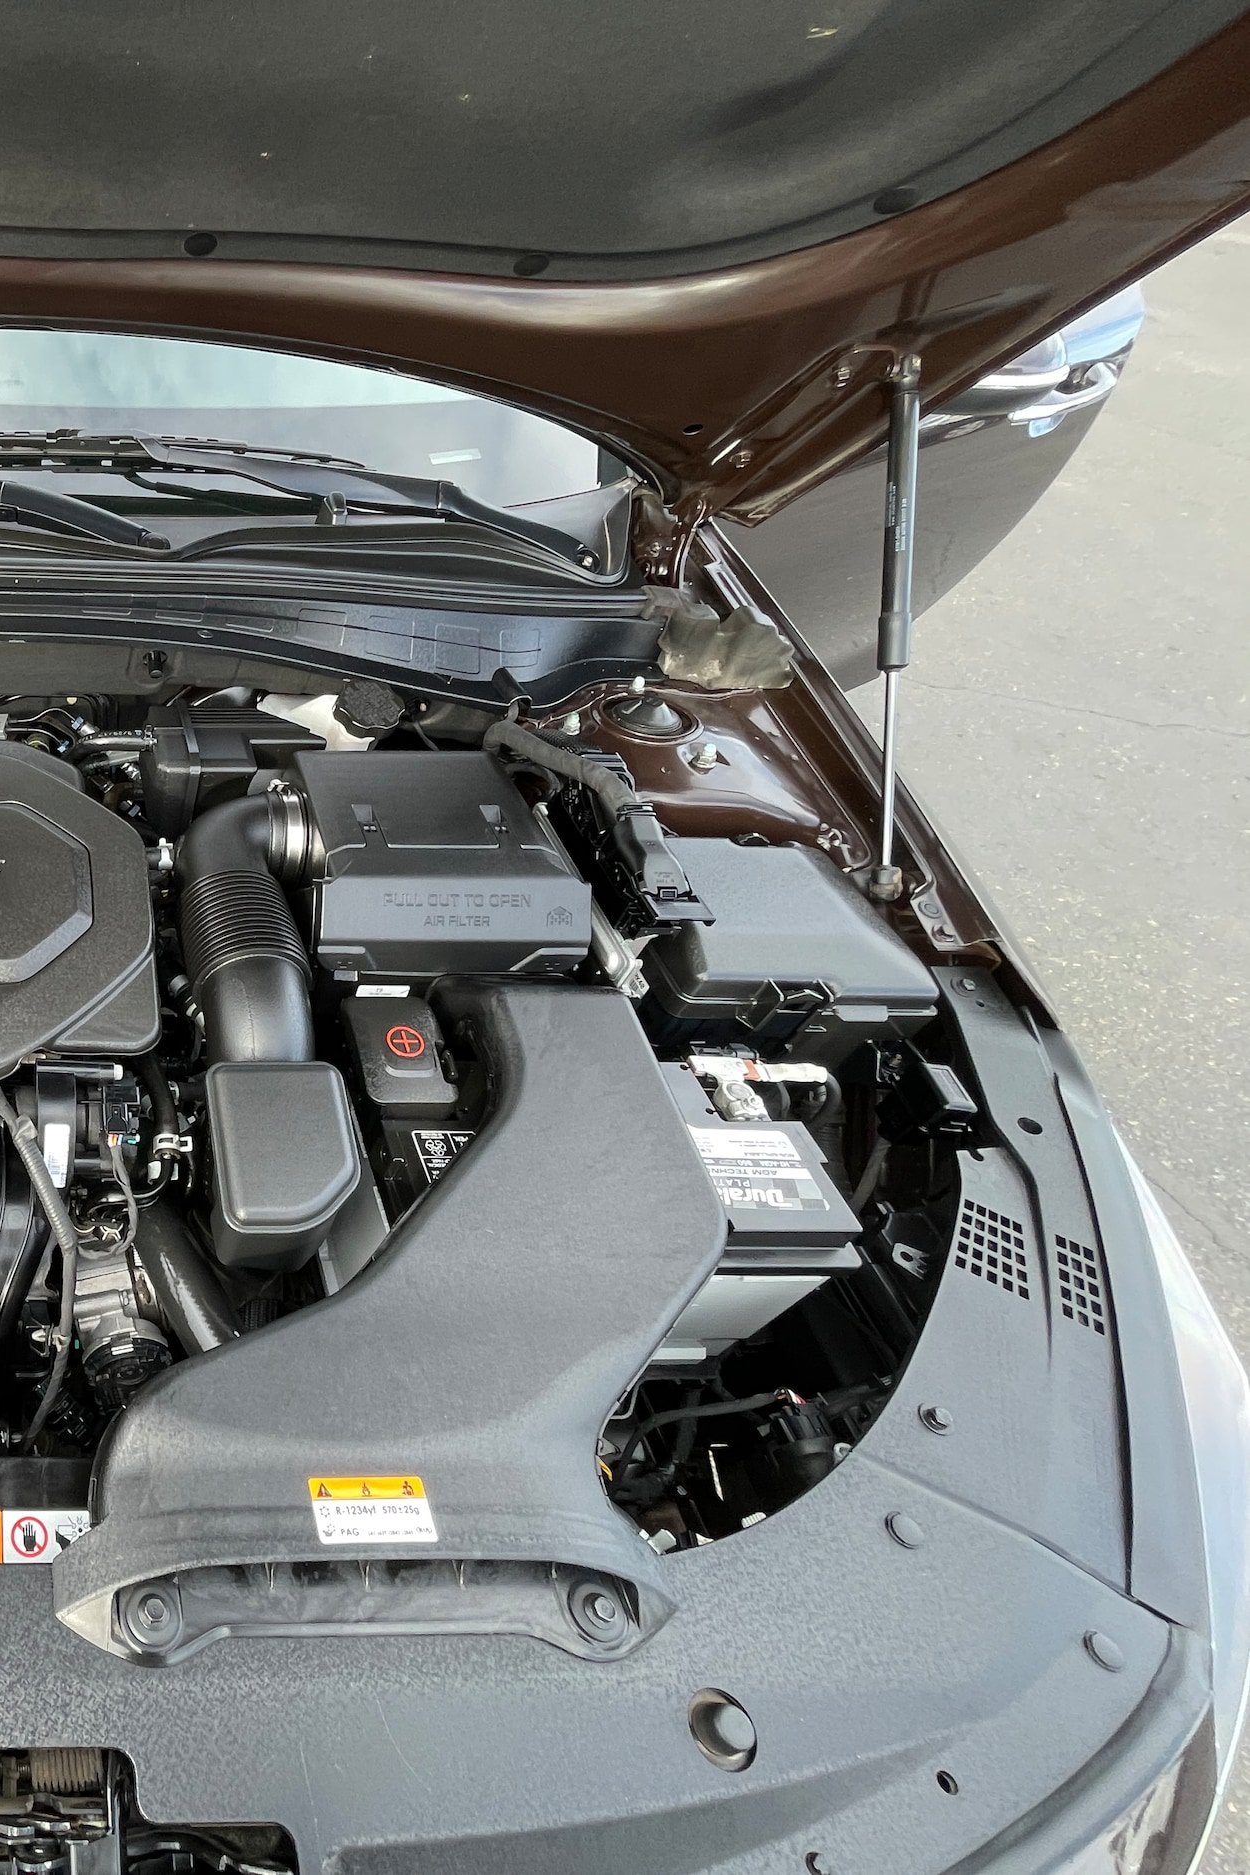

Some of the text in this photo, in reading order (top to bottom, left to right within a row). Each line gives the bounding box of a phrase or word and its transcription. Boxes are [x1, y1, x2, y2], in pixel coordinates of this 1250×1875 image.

[383, 893, 532, 908] PULL OUT TO OPEN
[423, 915, 490, 927] AIR FILTER
[340, 1528, 360, 1537] PAG
